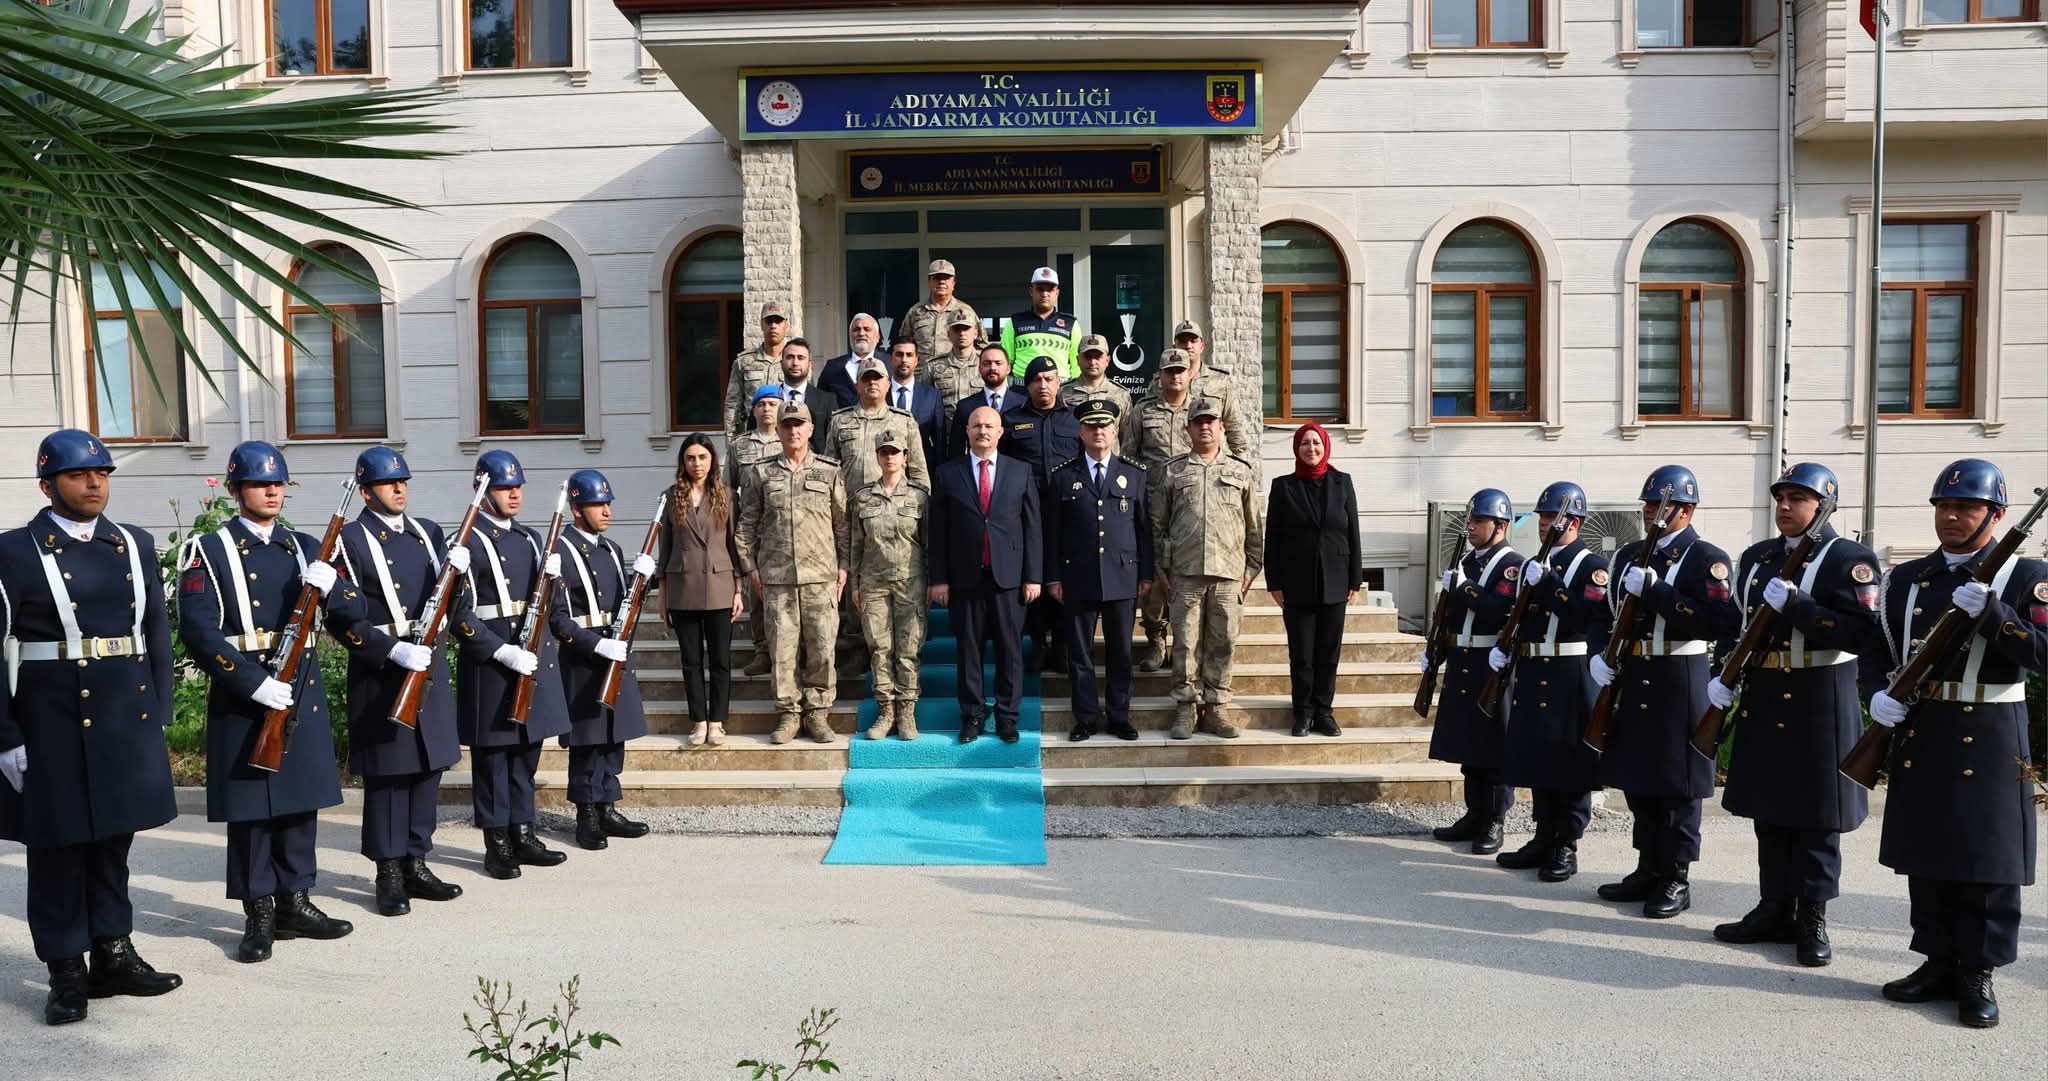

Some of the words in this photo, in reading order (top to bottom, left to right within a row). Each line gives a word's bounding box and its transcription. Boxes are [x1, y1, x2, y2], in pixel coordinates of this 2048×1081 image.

[980, 74, 1020, 89] T.C.
[889, 93, 1008, 109] ADIYAMAN
[1012, 88, 1112, 108] VALİLİĞİ
[844, 110, 867, 128] İL
[870, 111, 994, 128] JANDARMA
[998, 106, 1157, 126] KOMUTANLIĞI
[944, 167, 1008, 179] ADIYAMAN
[907, 181, 961, 193] MERKEZ
[962, 180, 1026, 191] JANDARMA
[1113, 375, 1145, 384] Evinize
